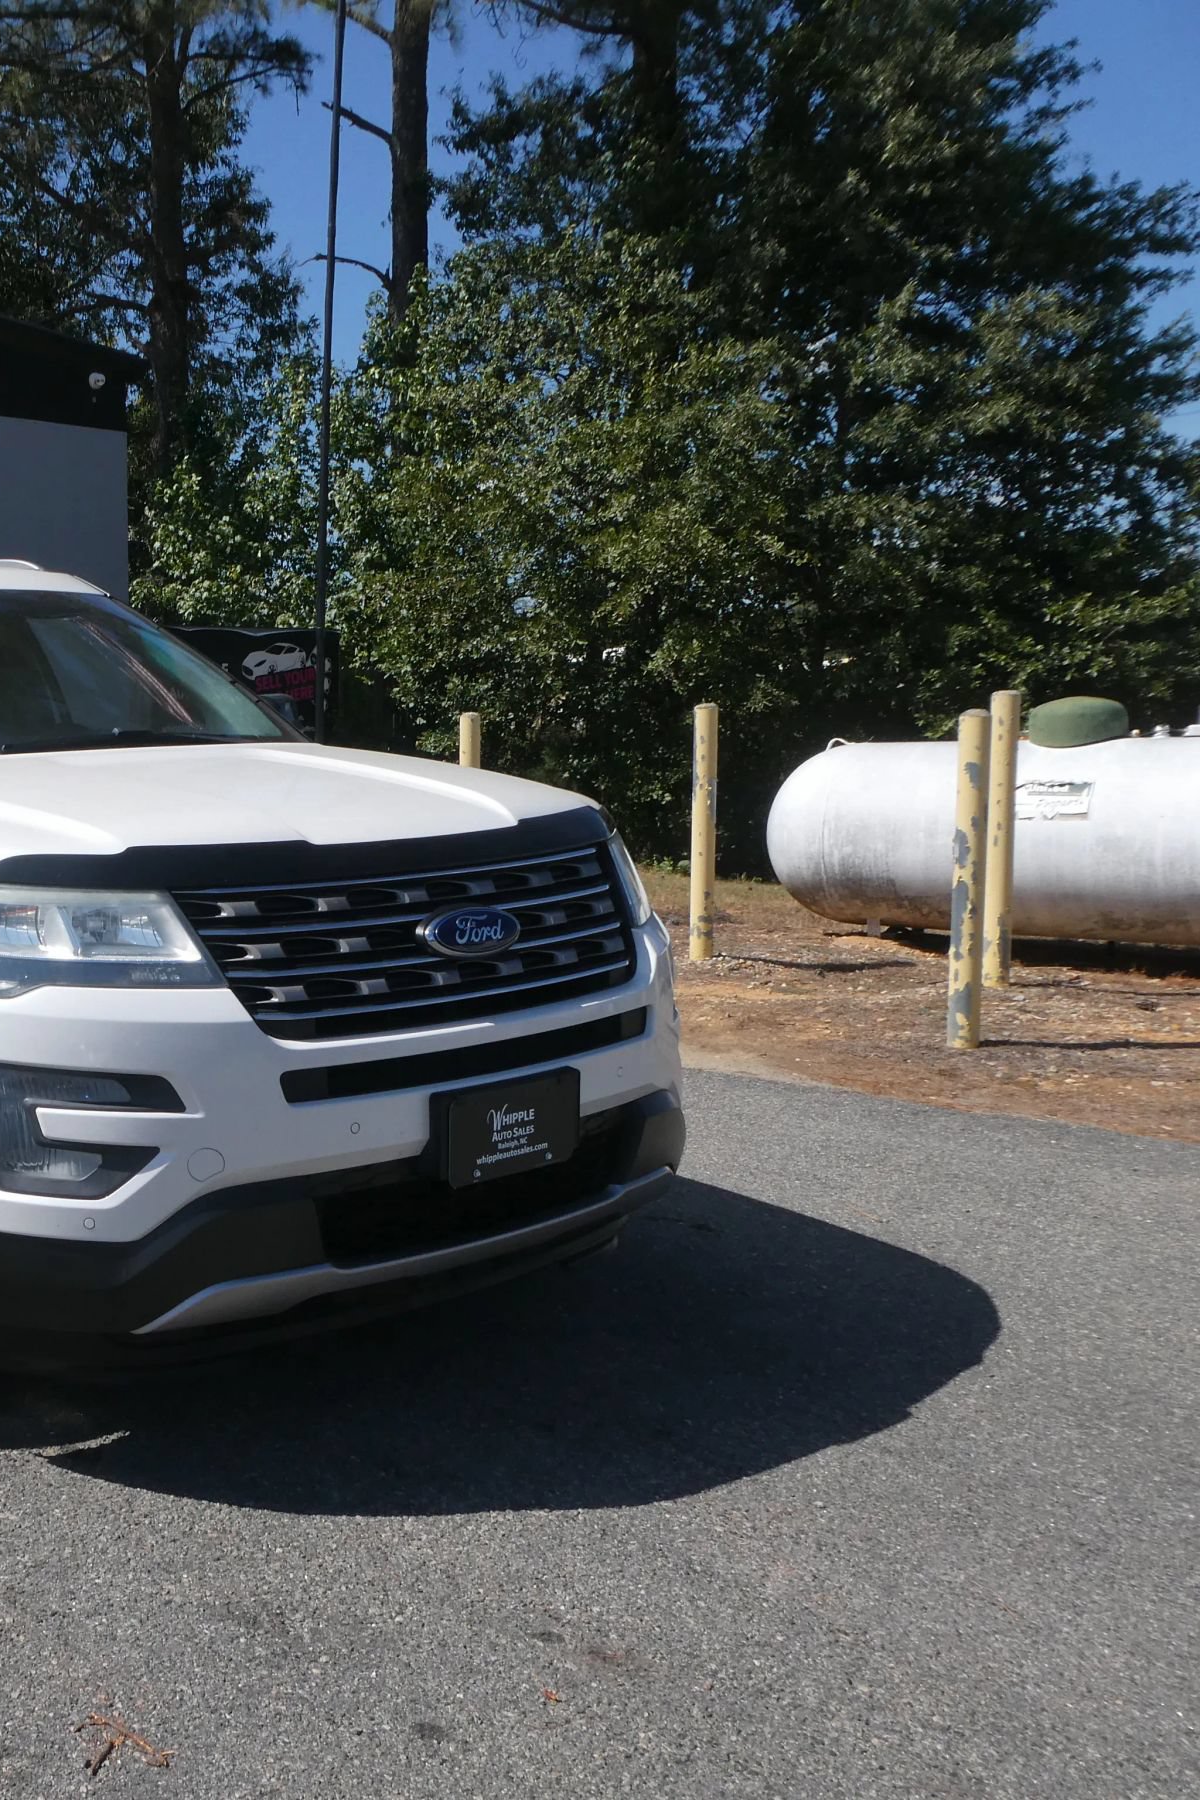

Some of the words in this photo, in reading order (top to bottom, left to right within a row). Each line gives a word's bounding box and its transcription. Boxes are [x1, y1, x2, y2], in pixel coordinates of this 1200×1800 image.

[256, 676, 280, 691] SELL
[285, 668, 316, 685] YOUR
[456, 914, 504, 945] Ford
[487, 1104, 535, 1131] WHIPPLE
[492, 1130, 513, 1142] AUTO
[513, 1125, 534, 1137] SALES
[476, 1142, 548, 1165] whippleautosales.com
